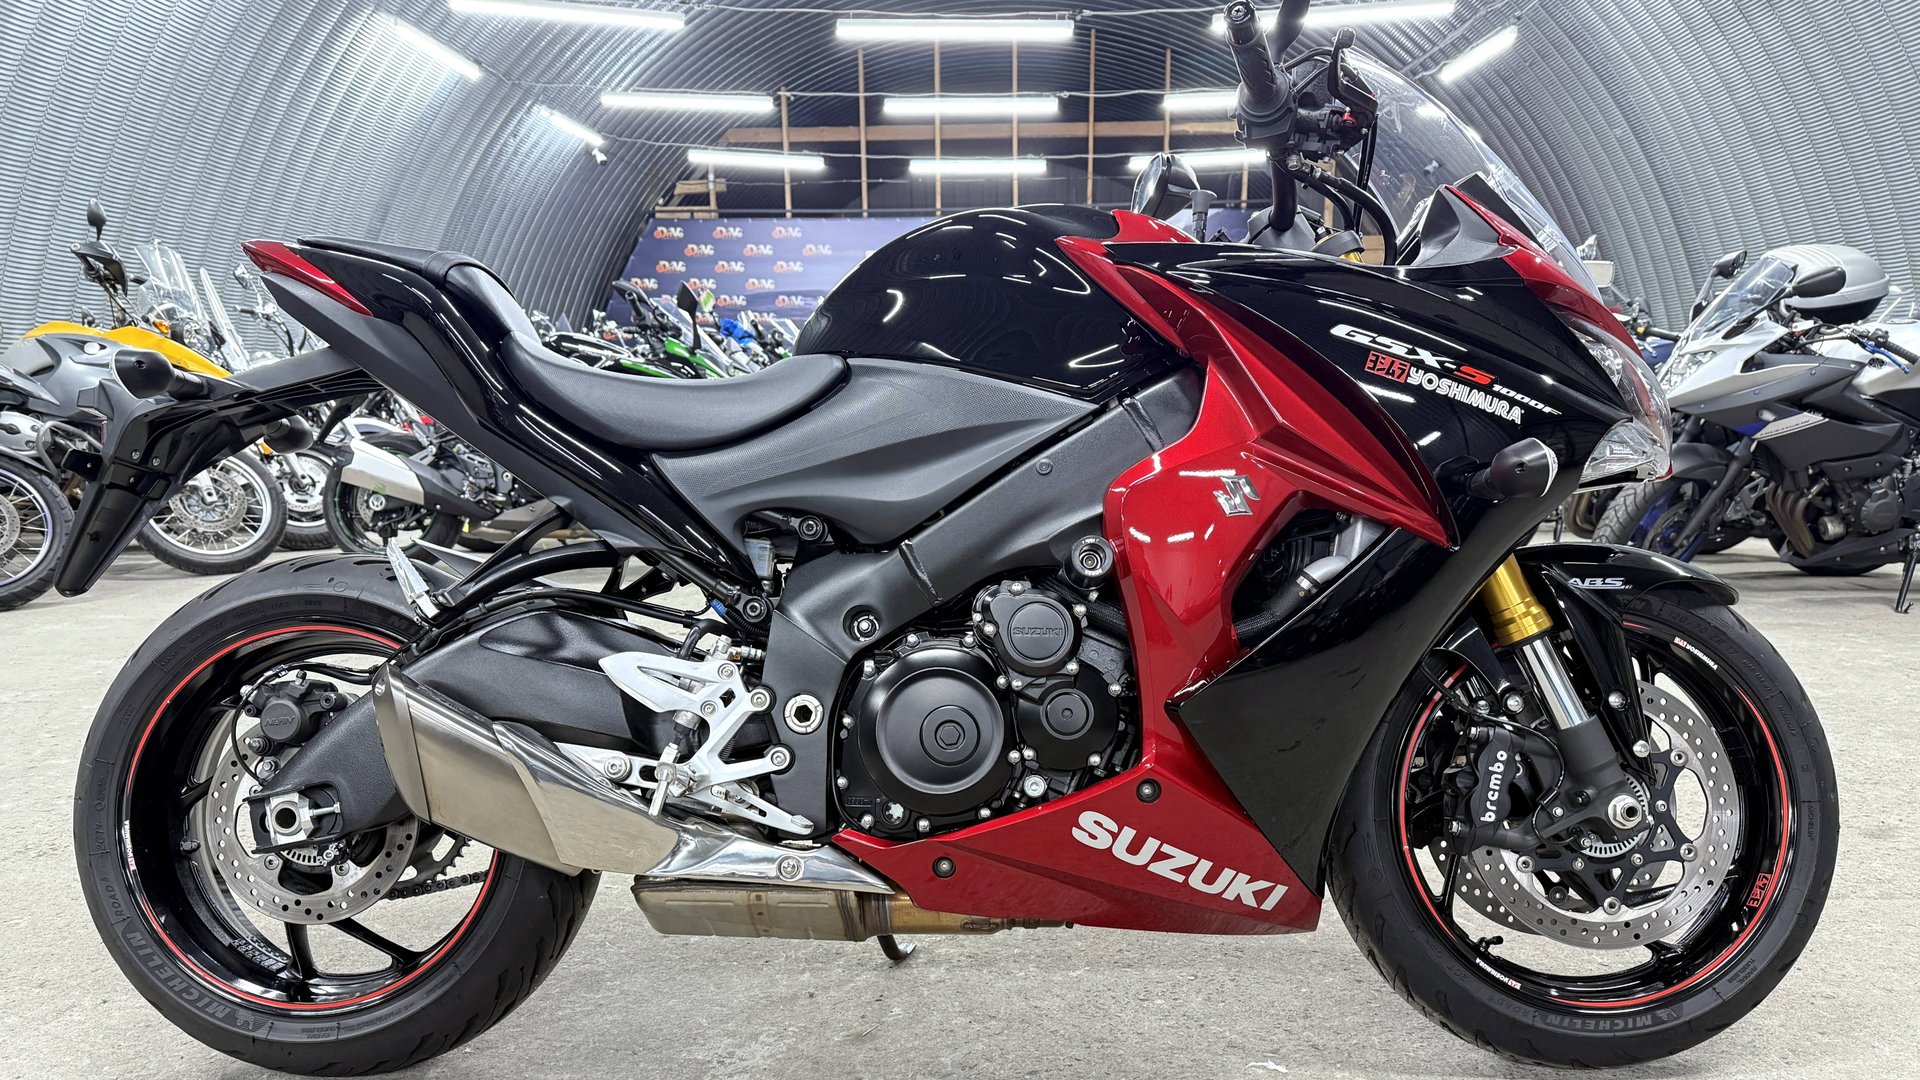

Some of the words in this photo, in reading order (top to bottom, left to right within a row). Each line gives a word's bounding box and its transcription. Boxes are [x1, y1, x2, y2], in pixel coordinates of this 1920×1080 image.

[1330, 324, 1498, 385] GSX-S
[1491, 384, 1562, 416] 1000F
[1407, 366, 1524, 425] YOSHIMURA
[1568, 577, 1626, 589] ABS
[1012, 626, 1063, 637] SUZUKI
[1071, 810, 1289, 911] SUZUKI
[105, 884, 125, 917] ROAD
[126, 931, 231, 1019] MICHELIN
[1545, 1013, 1653, 1031] MICHELIN
